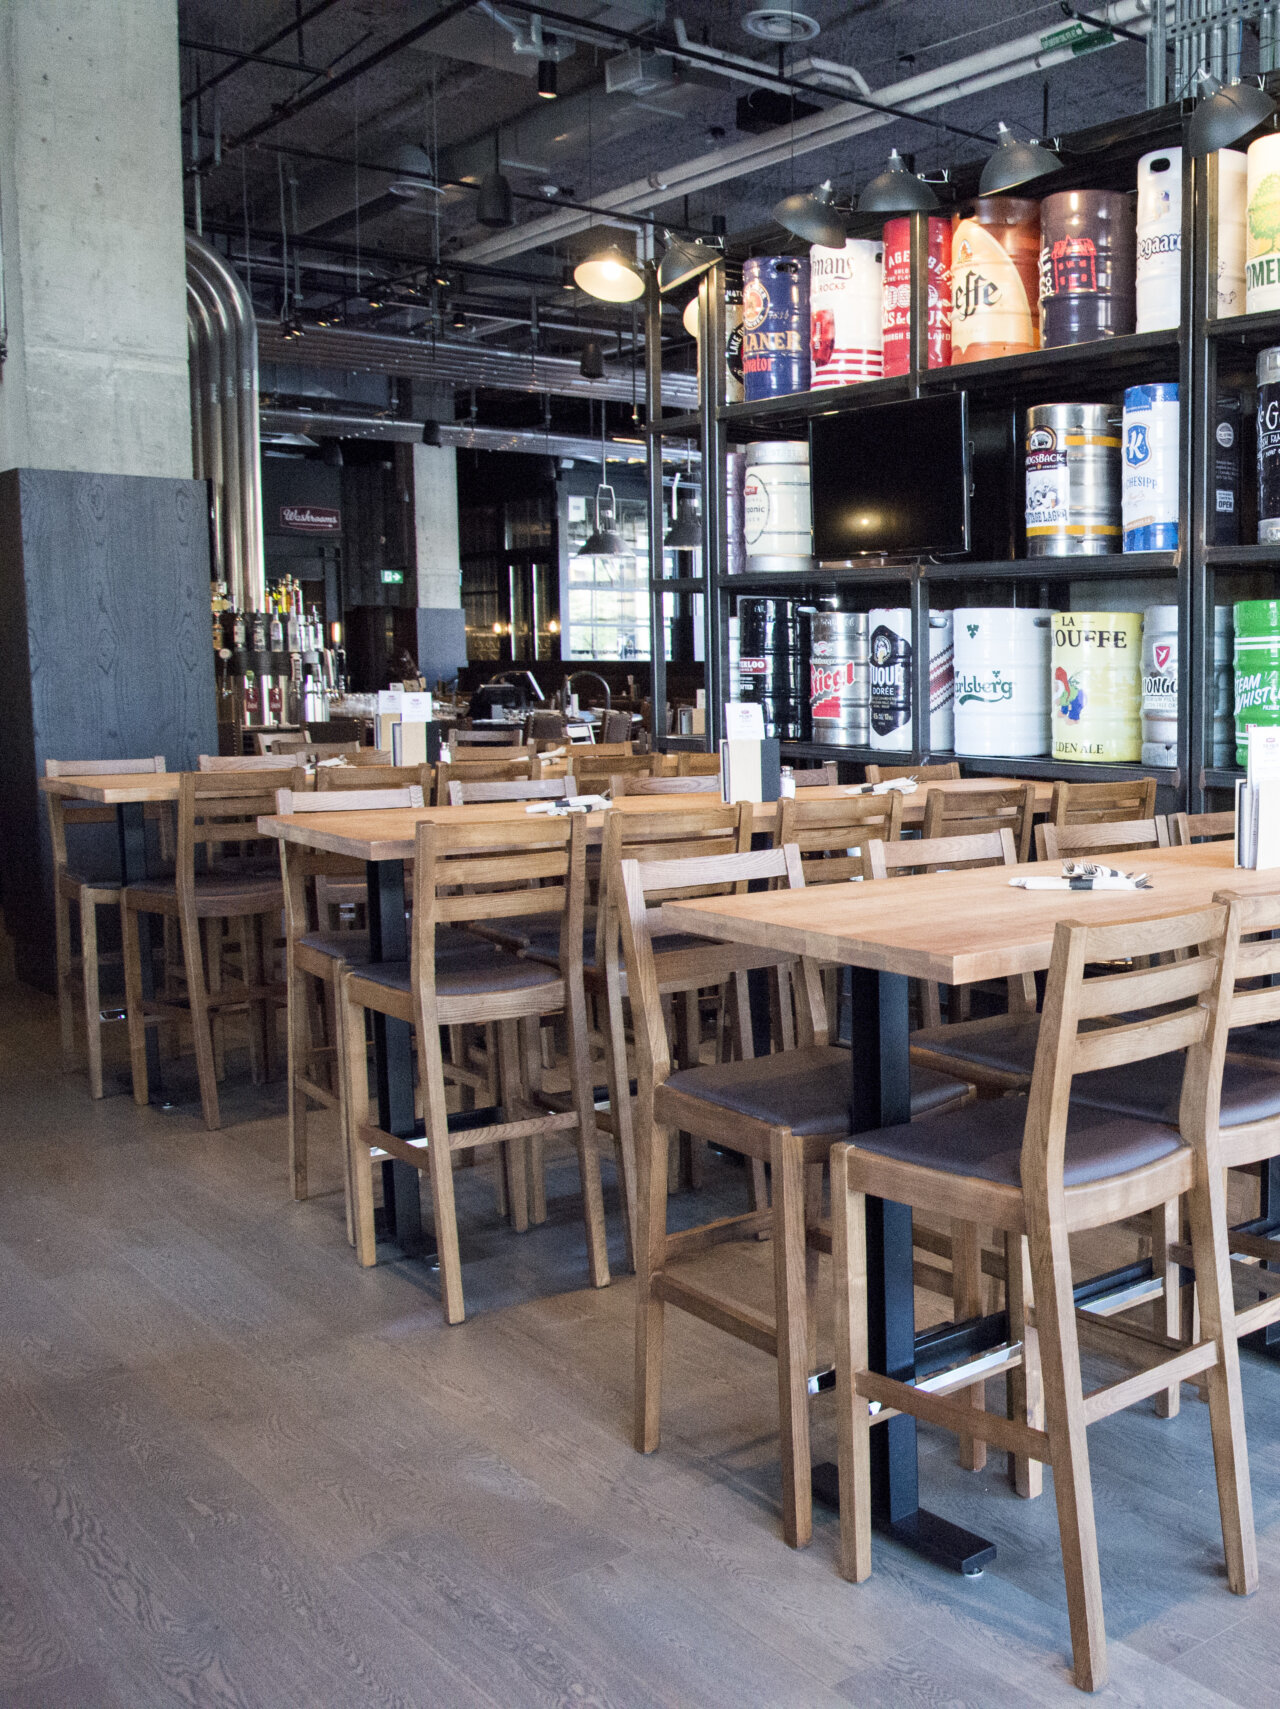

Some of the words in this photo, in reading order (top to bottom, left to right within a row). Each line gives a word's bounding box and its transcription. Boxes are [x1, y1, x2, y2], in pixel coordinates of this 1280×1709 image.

[889, 250, 911, 269] AGE
[1125, 429, 1147, 459] K
[1218, 500, 1233, 509] OPEN
[283, 509, 338, 523] Washrooms
[1062, 617, 1075, 627] LA
[872, 662, 905, 687] UQUE
[1080, 744, 1104, 755] ALE
